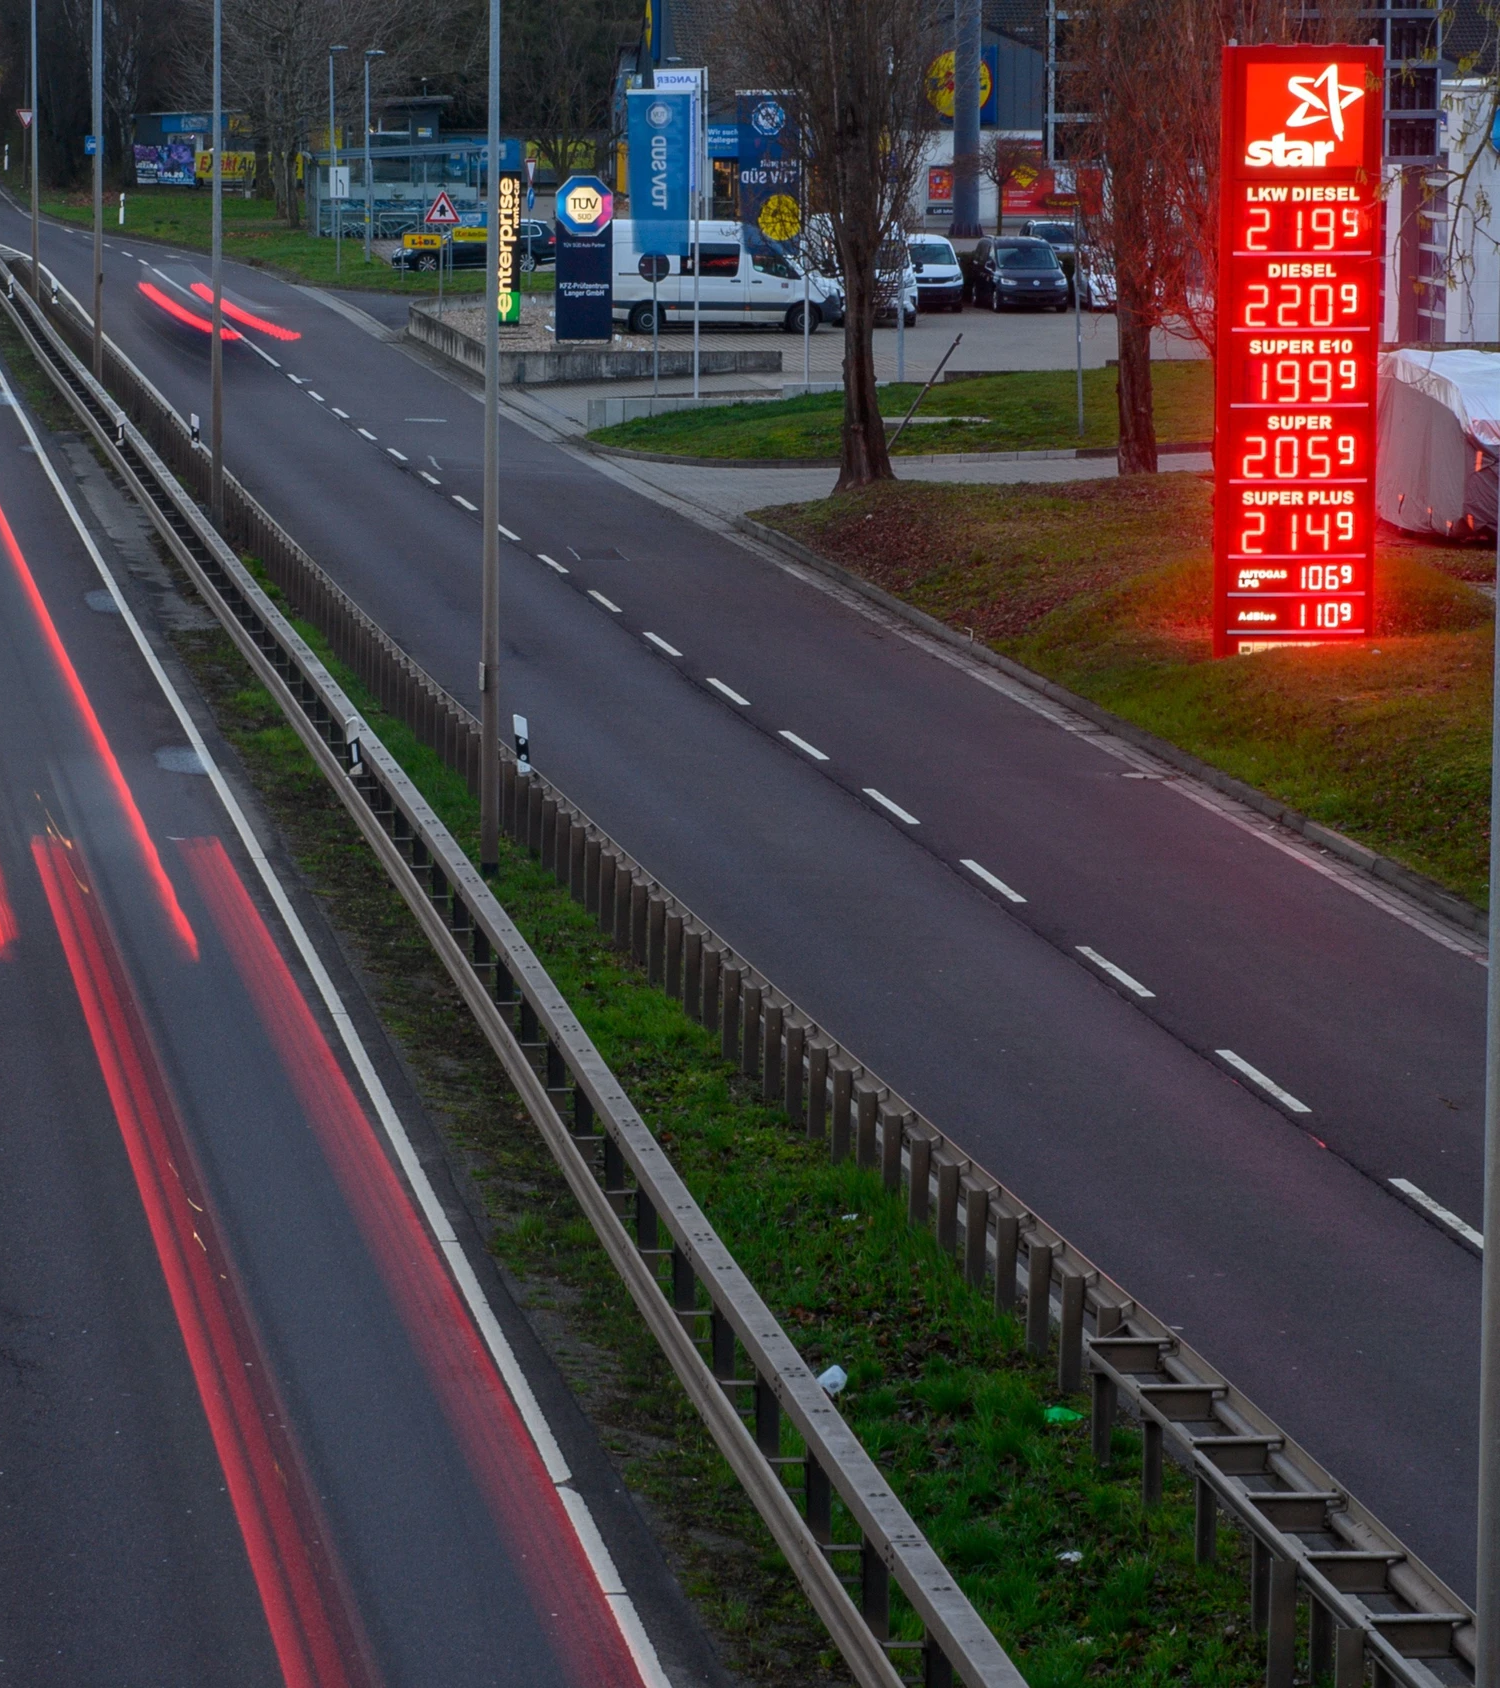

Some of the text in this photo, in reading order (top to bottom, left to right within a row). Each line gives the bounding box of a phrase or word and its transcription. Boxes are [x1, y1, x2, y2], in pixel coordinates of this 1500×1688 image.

[1245, 132, 1334, 167] star
[1247, 187, 1360, 202] LKW DIESEL
[571, 197, 599, 210] TÜV
[1247, 208, 1359, 250] 2199
[411, 235, 437, 247] LIDL
[497, 177, 517, 322] enterprise
[1268, 263, 1337, 278] DIESEL
[559, 282, 609, 290] KFZ-Prüfzentrum
[564, 289, 605, 298] Langer GmbH
[1245, 284, 1357, 327] 2209
[1249, 339, 1353, 354] SUPER E10
[1262, 360, 1356, 402] 1999
[1267, 415, 1332, 430] SUPER
[1243, 435, 1354, 478] 2059
[1242, 490, 1355, 505] SUPER PLUS
[1242, 511, 1353, 553] 2149
[1238, 565, 1352, 590] AUTOGAS 1069
[1238, 579, 1260, 588] LPG
[1238, 602, 1351, 627] AdBlue 1109
